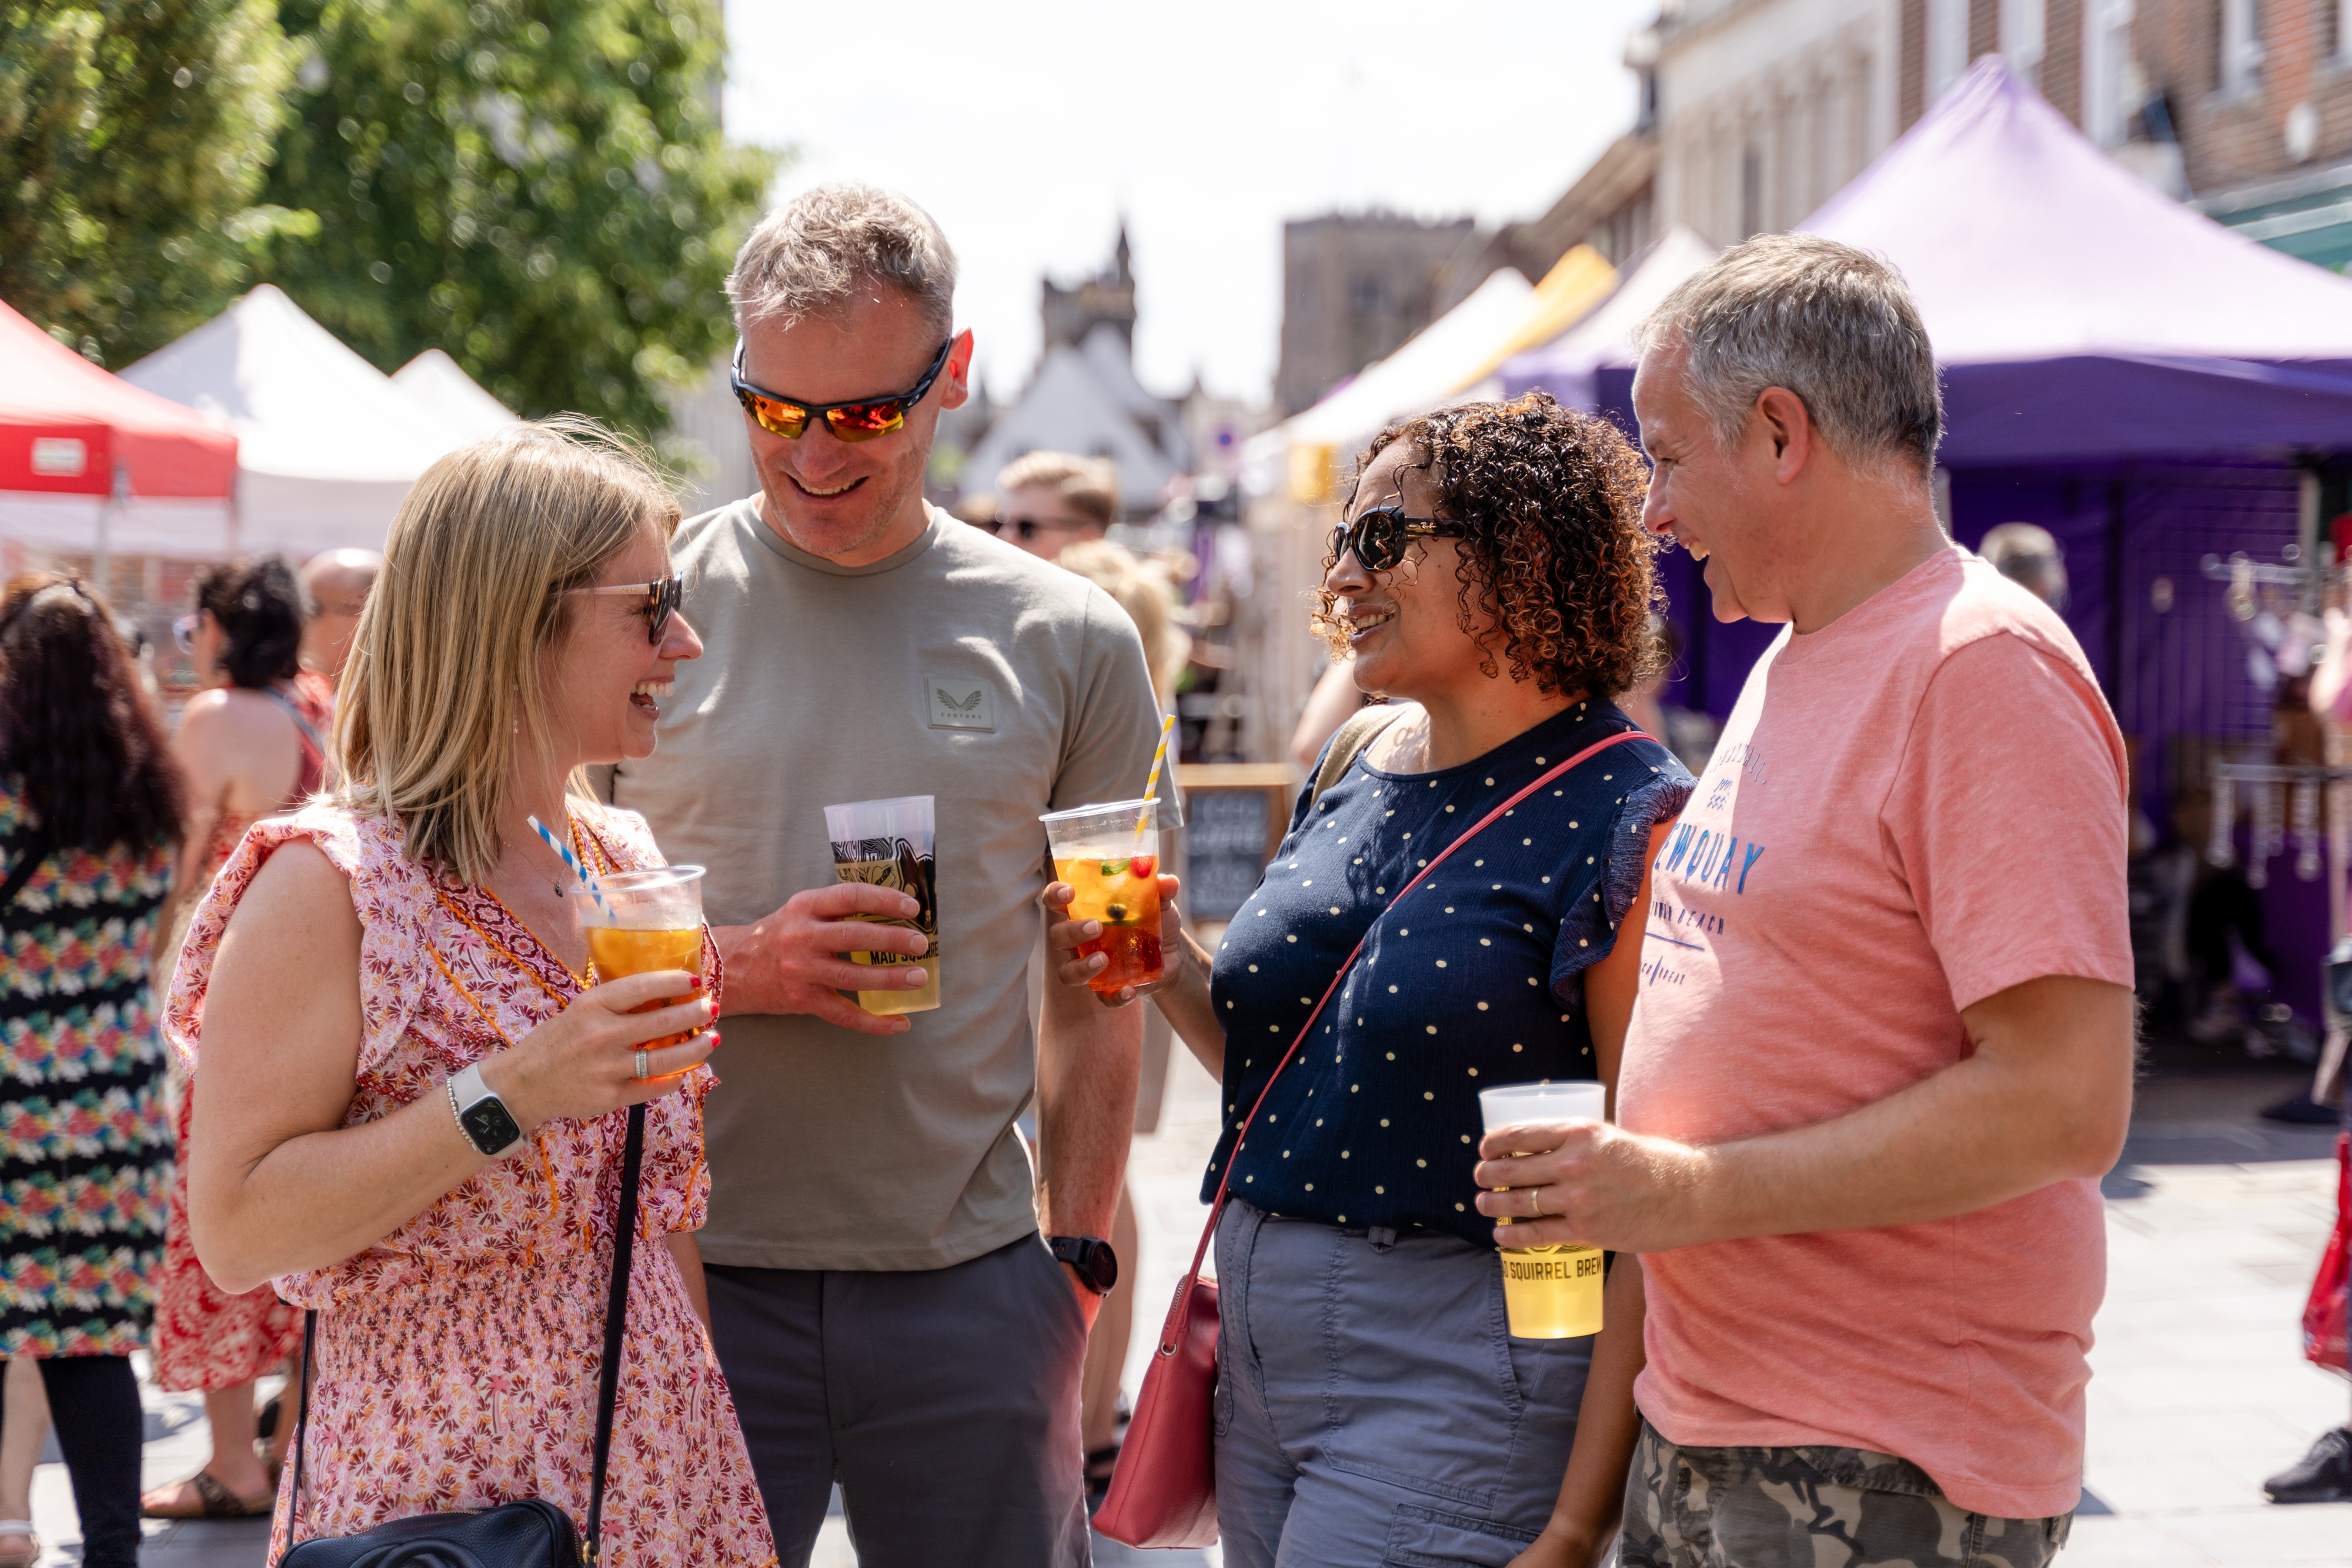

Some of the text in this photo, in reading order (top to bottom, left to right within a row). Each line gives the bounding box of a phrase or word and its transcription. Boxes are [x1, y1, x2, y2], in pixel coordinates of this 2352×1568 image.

[1655, 823, 1764, 894] EWQUAY
[1678, 908, 1724, 935] BEACH
[870, 951, 896, 965] MAD
[1510, 1261, 1571, 1282] SQUIRREL
